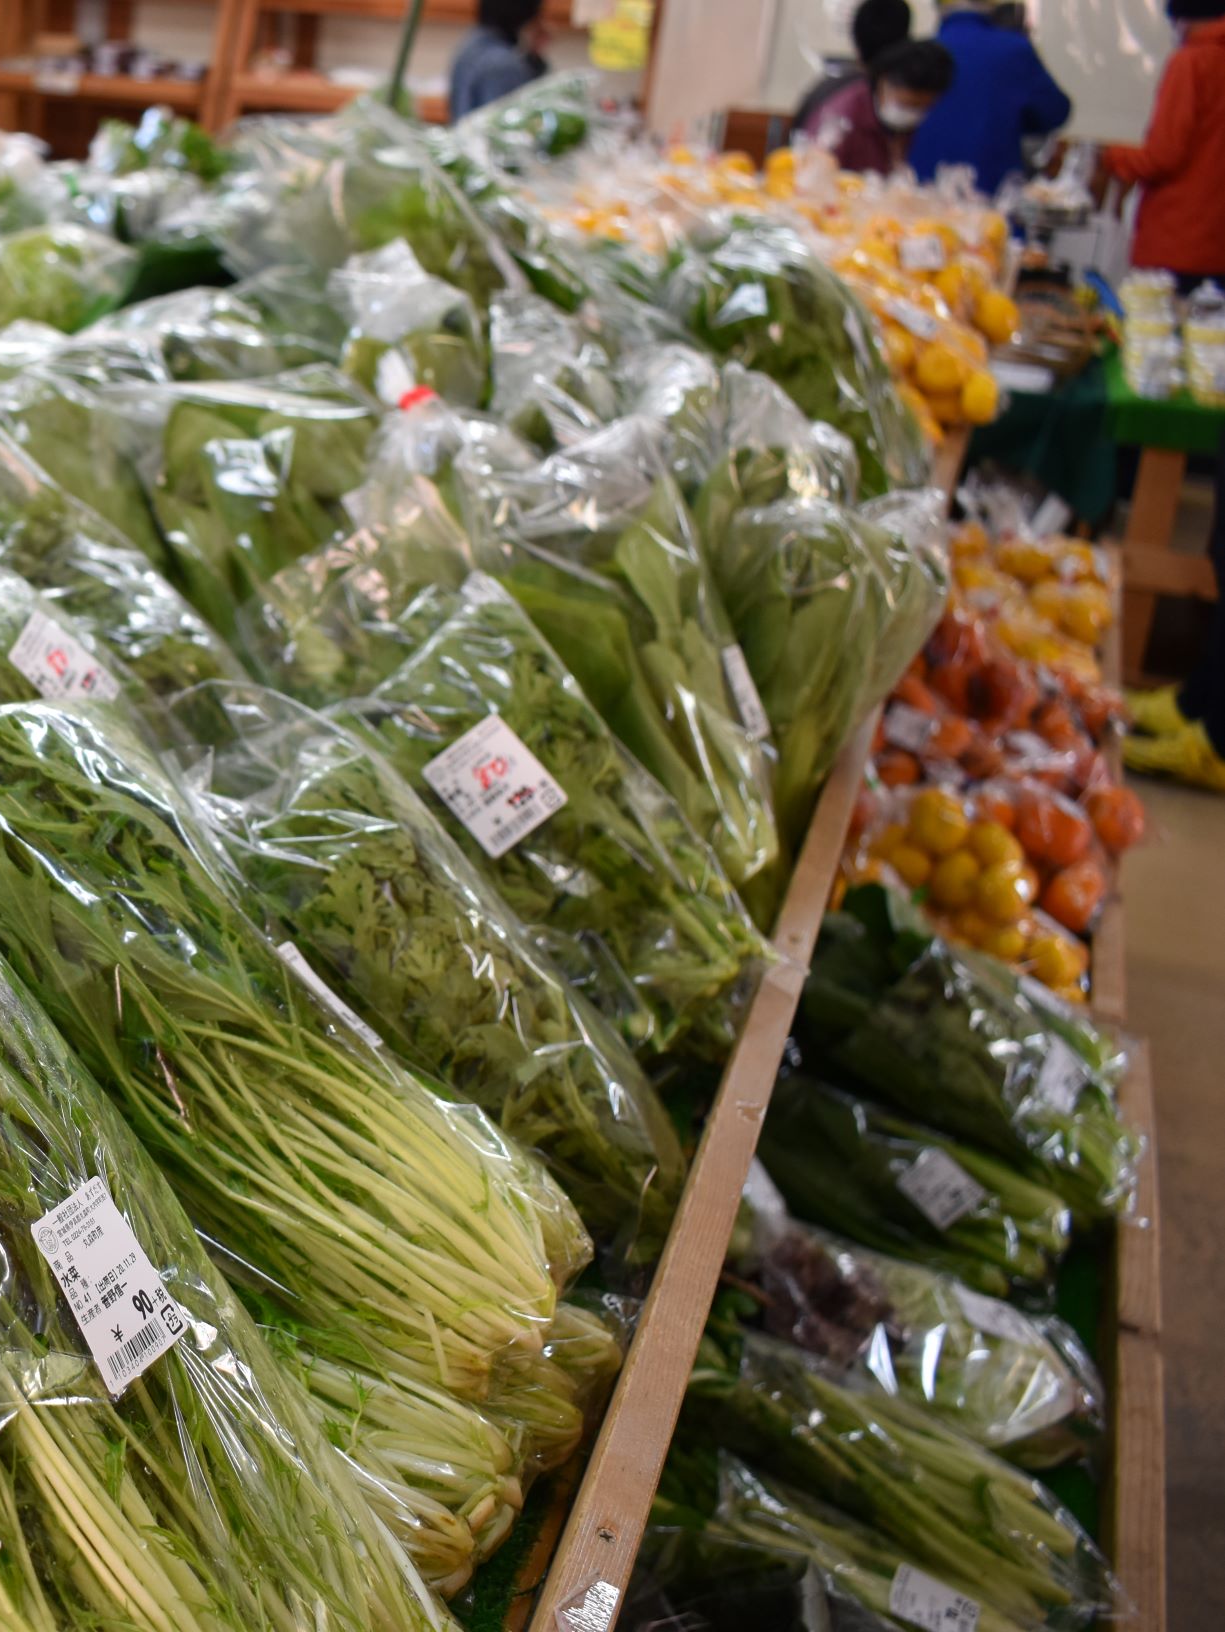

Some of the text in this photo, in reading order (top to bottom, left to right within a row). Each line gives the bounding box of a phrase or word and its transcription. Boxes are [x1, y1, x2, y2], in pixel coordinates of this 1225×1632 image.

[52, 1199, 83, 1225] 一般社団法人
[62, 1237, 72, 1247] TEL
[83, 1225, 104, 1248] 丸森町産
[60, 1265, 81, 1288] 水菜
[81, 1282, 127, 1326] 生産者 菅野信一
[83, 1292, 92, 1303] 41
[110, 1324, 123, 1342] ¥
[132, 1289, 154, 1320] 90
